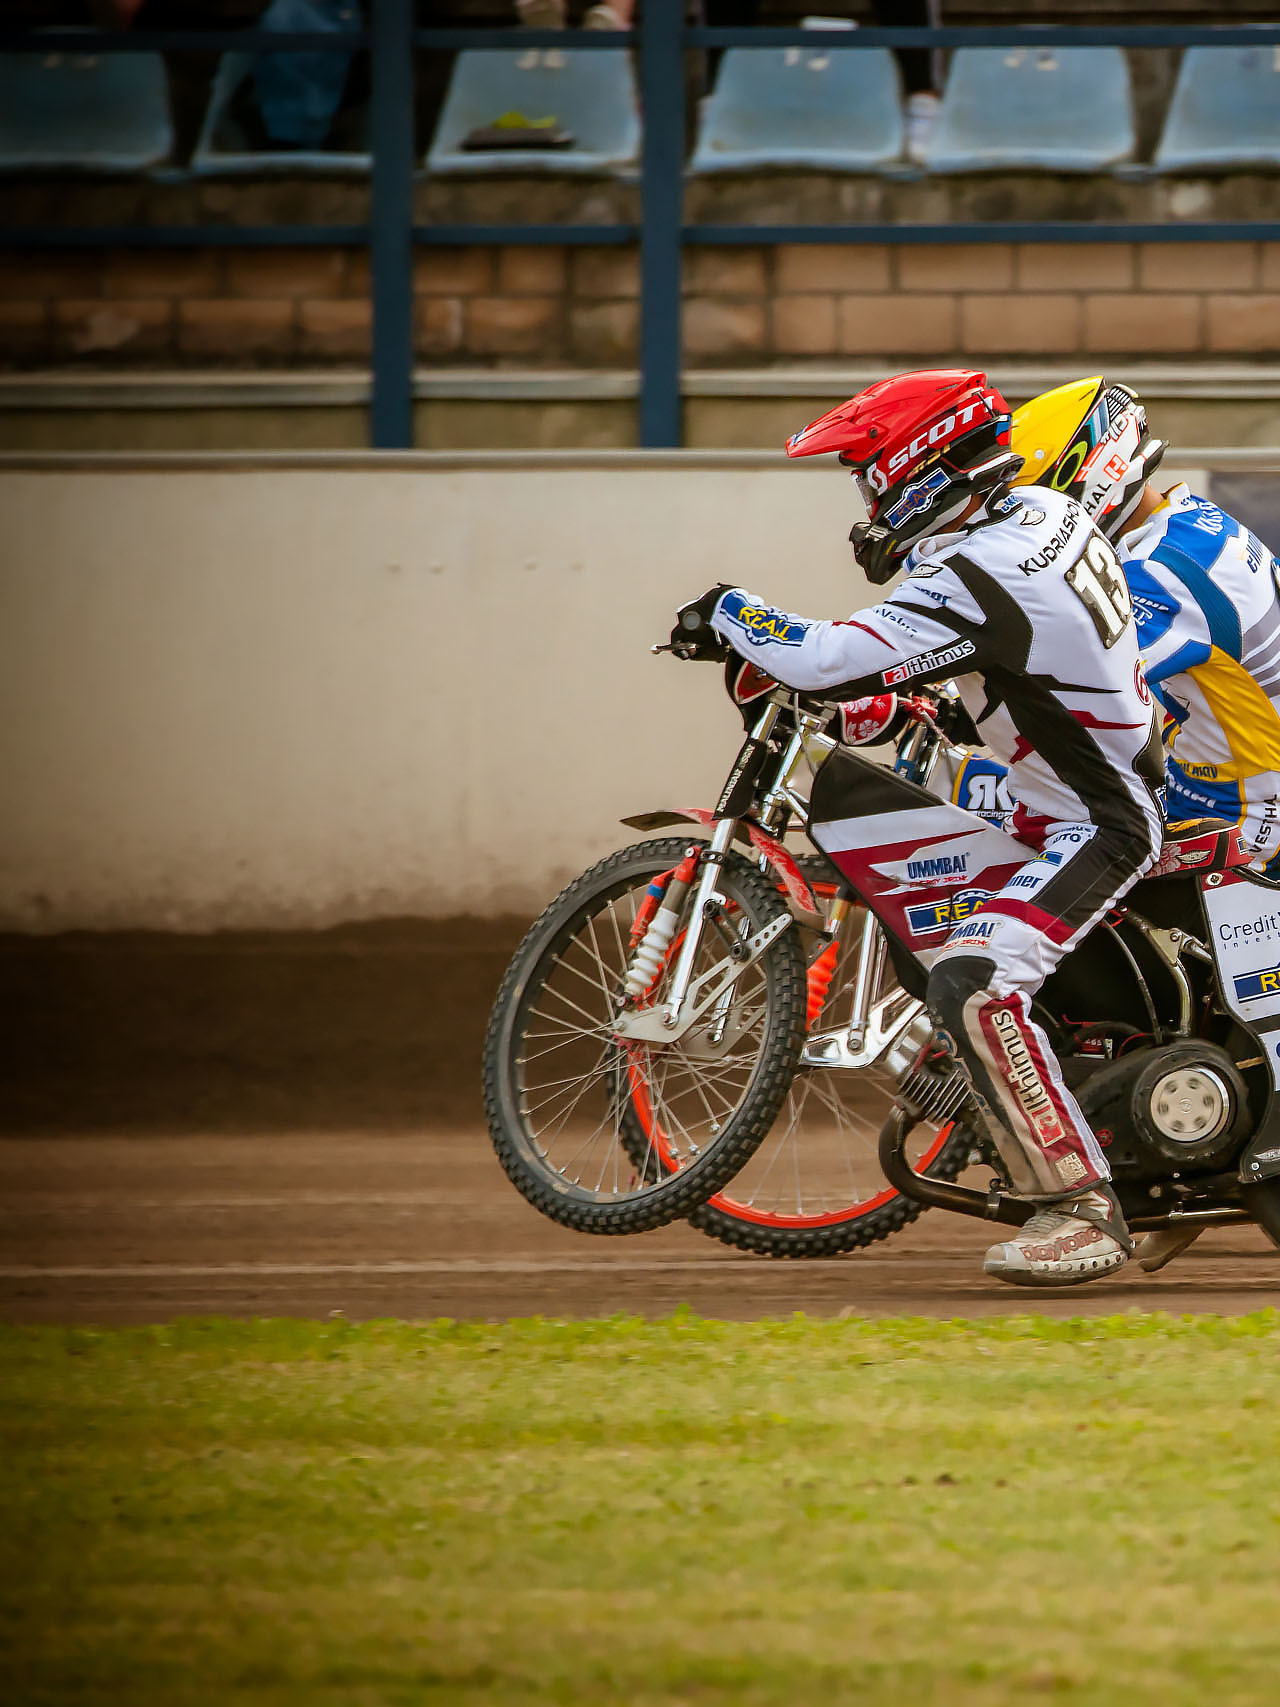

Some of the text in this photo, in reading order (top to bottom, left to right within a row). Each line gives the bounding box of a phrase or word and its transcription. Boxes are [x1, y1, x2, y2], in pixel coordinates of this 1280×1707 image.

[889, 396, 995, 476] SCOTT
[1073, 536, 1132, 636] 13
[884, 641, 975, 685] althimus
[935, 900, 985, 923] REA
[992, 1010, 1066, 1147] althimus
